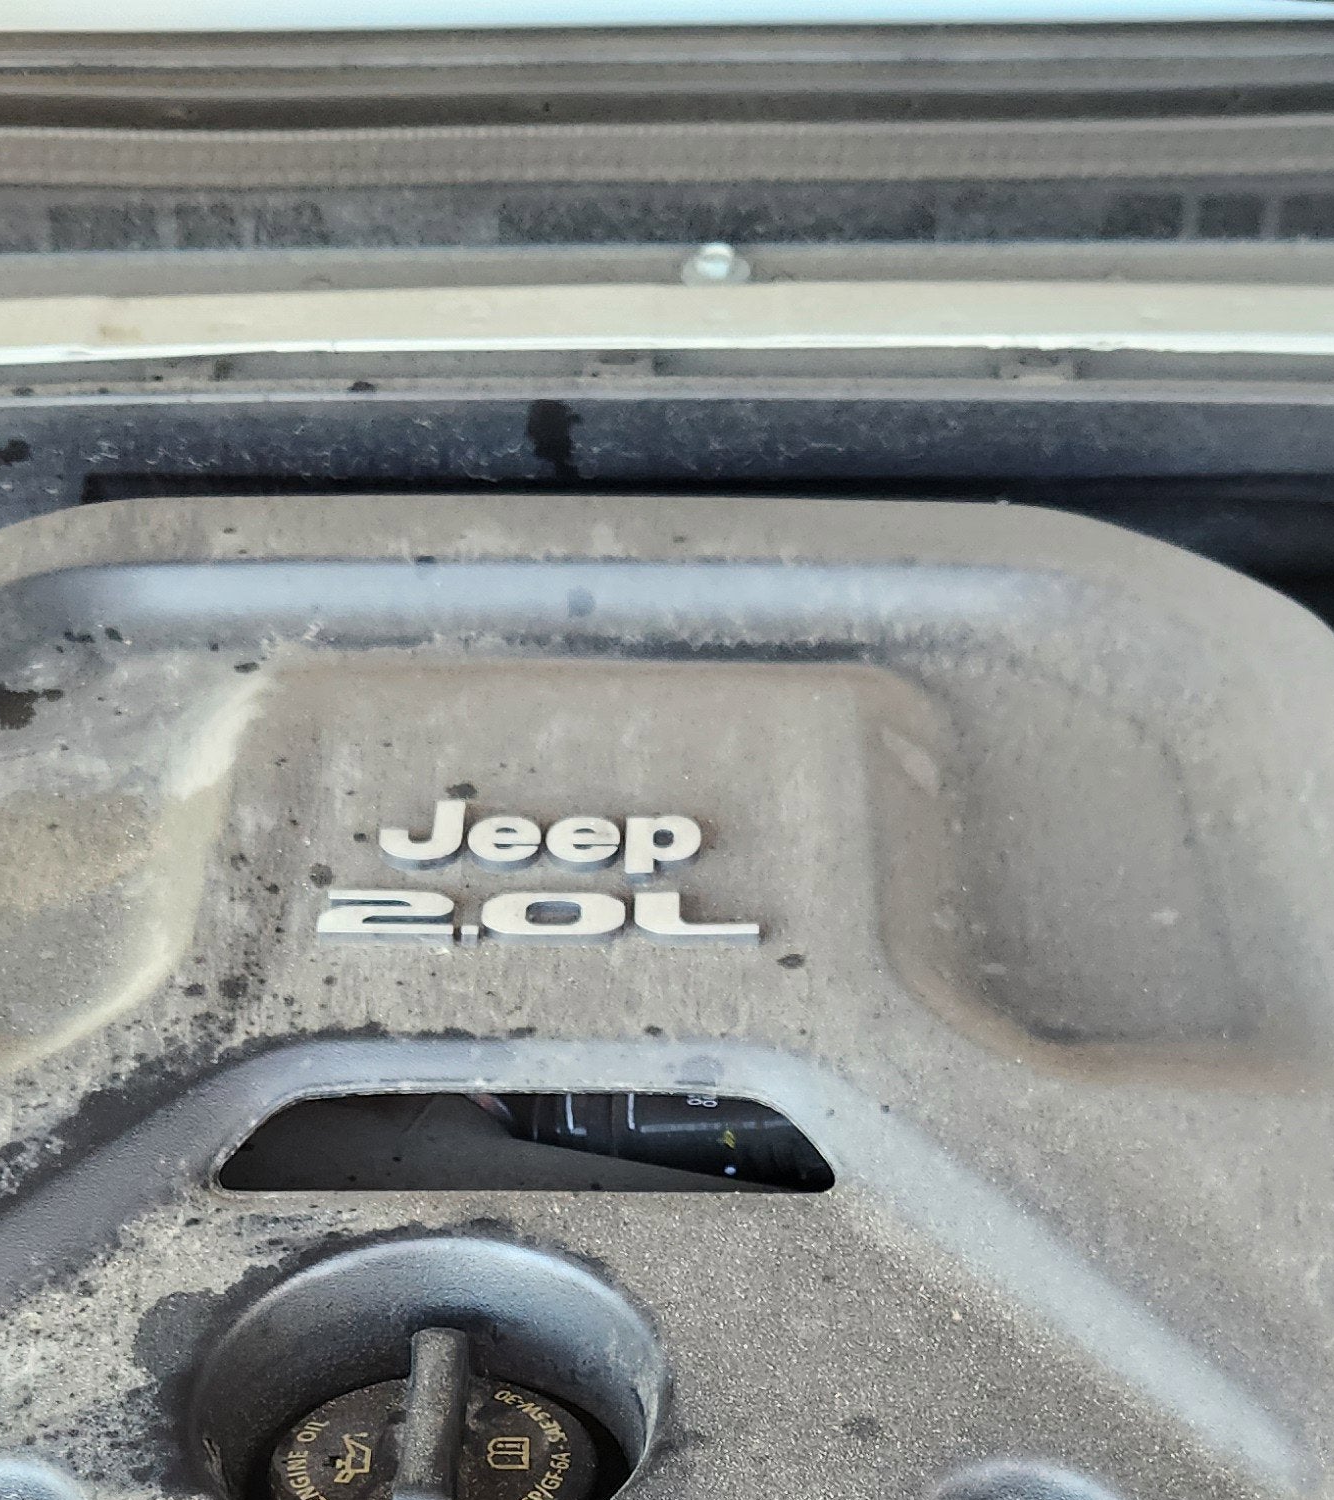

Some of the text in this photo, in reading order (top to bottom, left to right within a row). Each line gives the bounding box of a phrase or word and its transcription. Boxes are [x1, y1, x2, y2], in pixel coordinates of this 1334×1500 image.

[378, 800, 702, 880] Jeep
[317, 889, 760, 941] 2.0L
[296, 1420, 330, 1443] OIL
